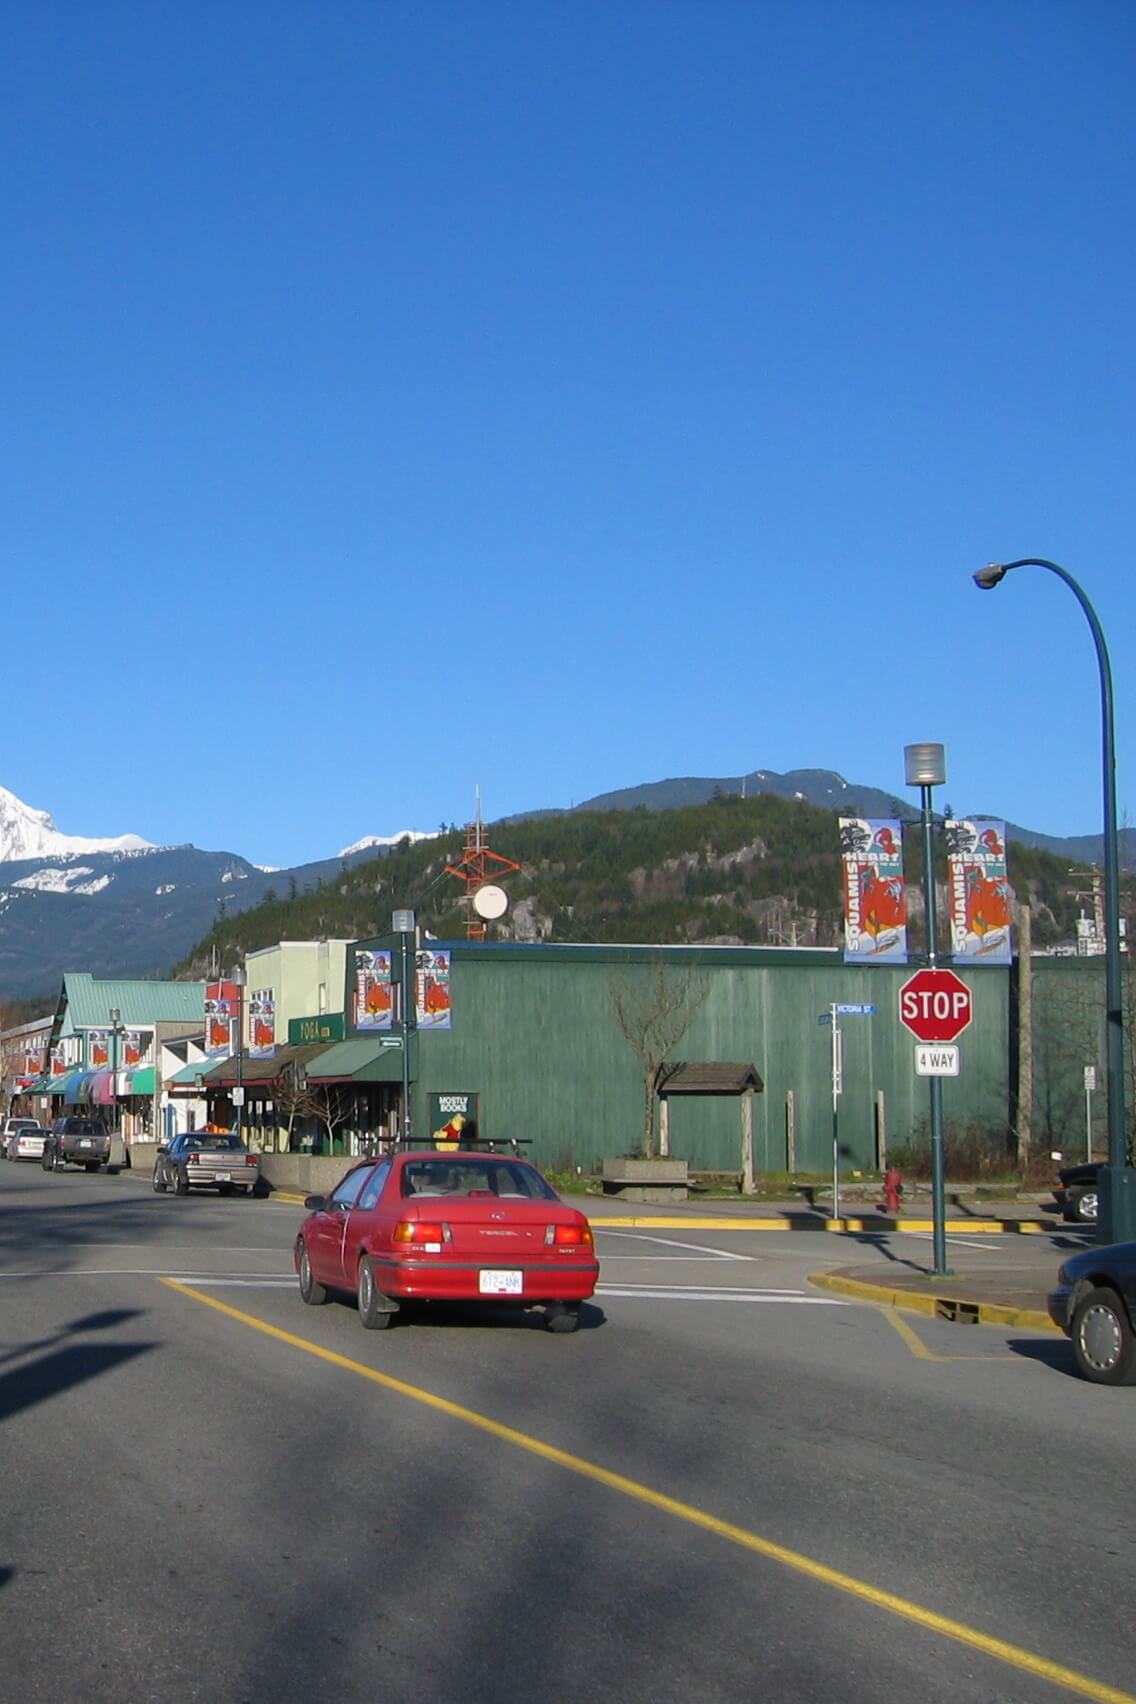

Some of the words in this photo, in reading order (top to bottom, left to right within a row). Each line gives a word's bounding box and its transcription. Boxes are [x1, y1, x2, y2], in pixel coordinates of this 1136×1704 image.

[903, 991, 969, 1020] STOP
[920, 1054, 927, 1067] 4
[929, 1053, 954, 1068] WAY
[438, 1096, 469, 1104] MOSTLY
[440, 1104, 467, 1112] BOOKS
